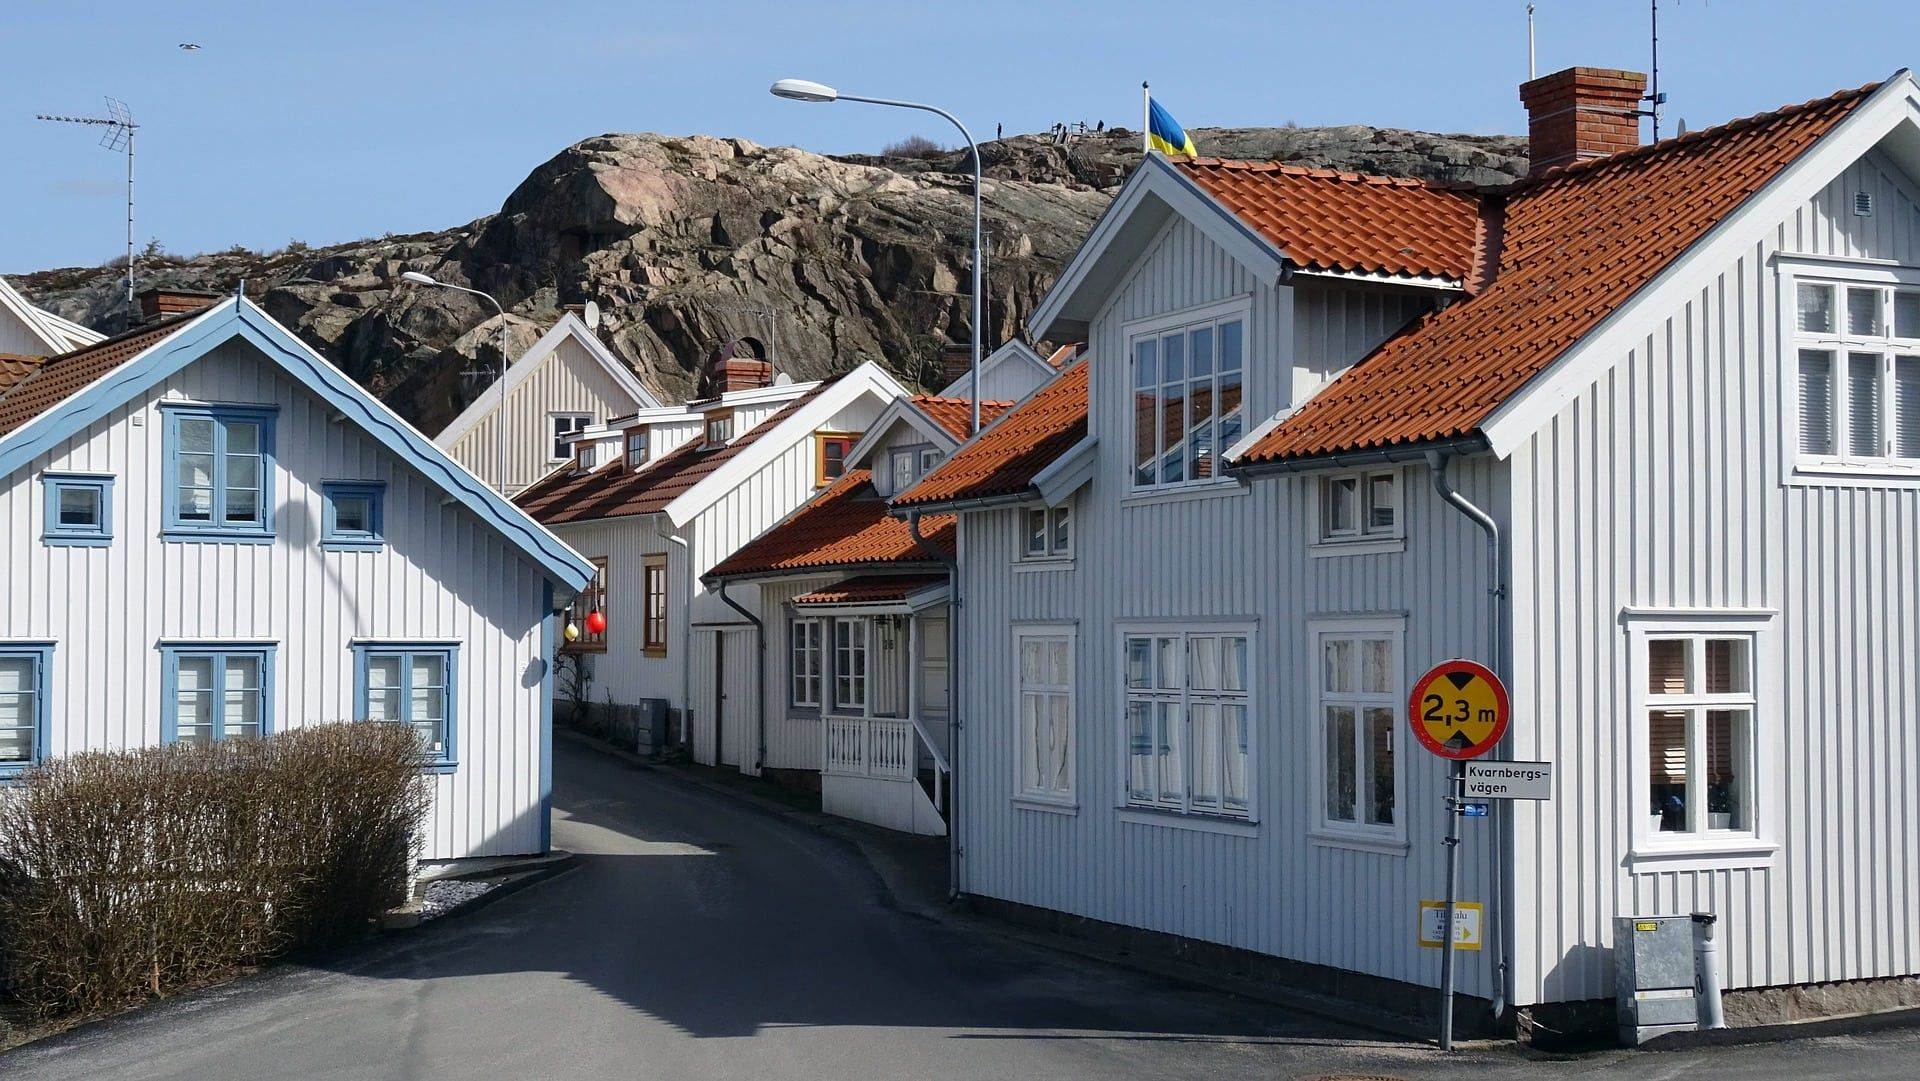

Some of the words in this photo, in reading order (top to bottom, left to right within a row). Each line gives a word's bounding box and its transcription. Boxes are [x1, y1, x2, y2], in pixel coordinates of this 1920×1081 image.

[1423, 694, 1470, 727] 2,3
[1478, 708, 1496, 723] m
[1469, 766, 1549, 781] Kvarnbergs-
[1470, 782, 1507, 795] vägen
